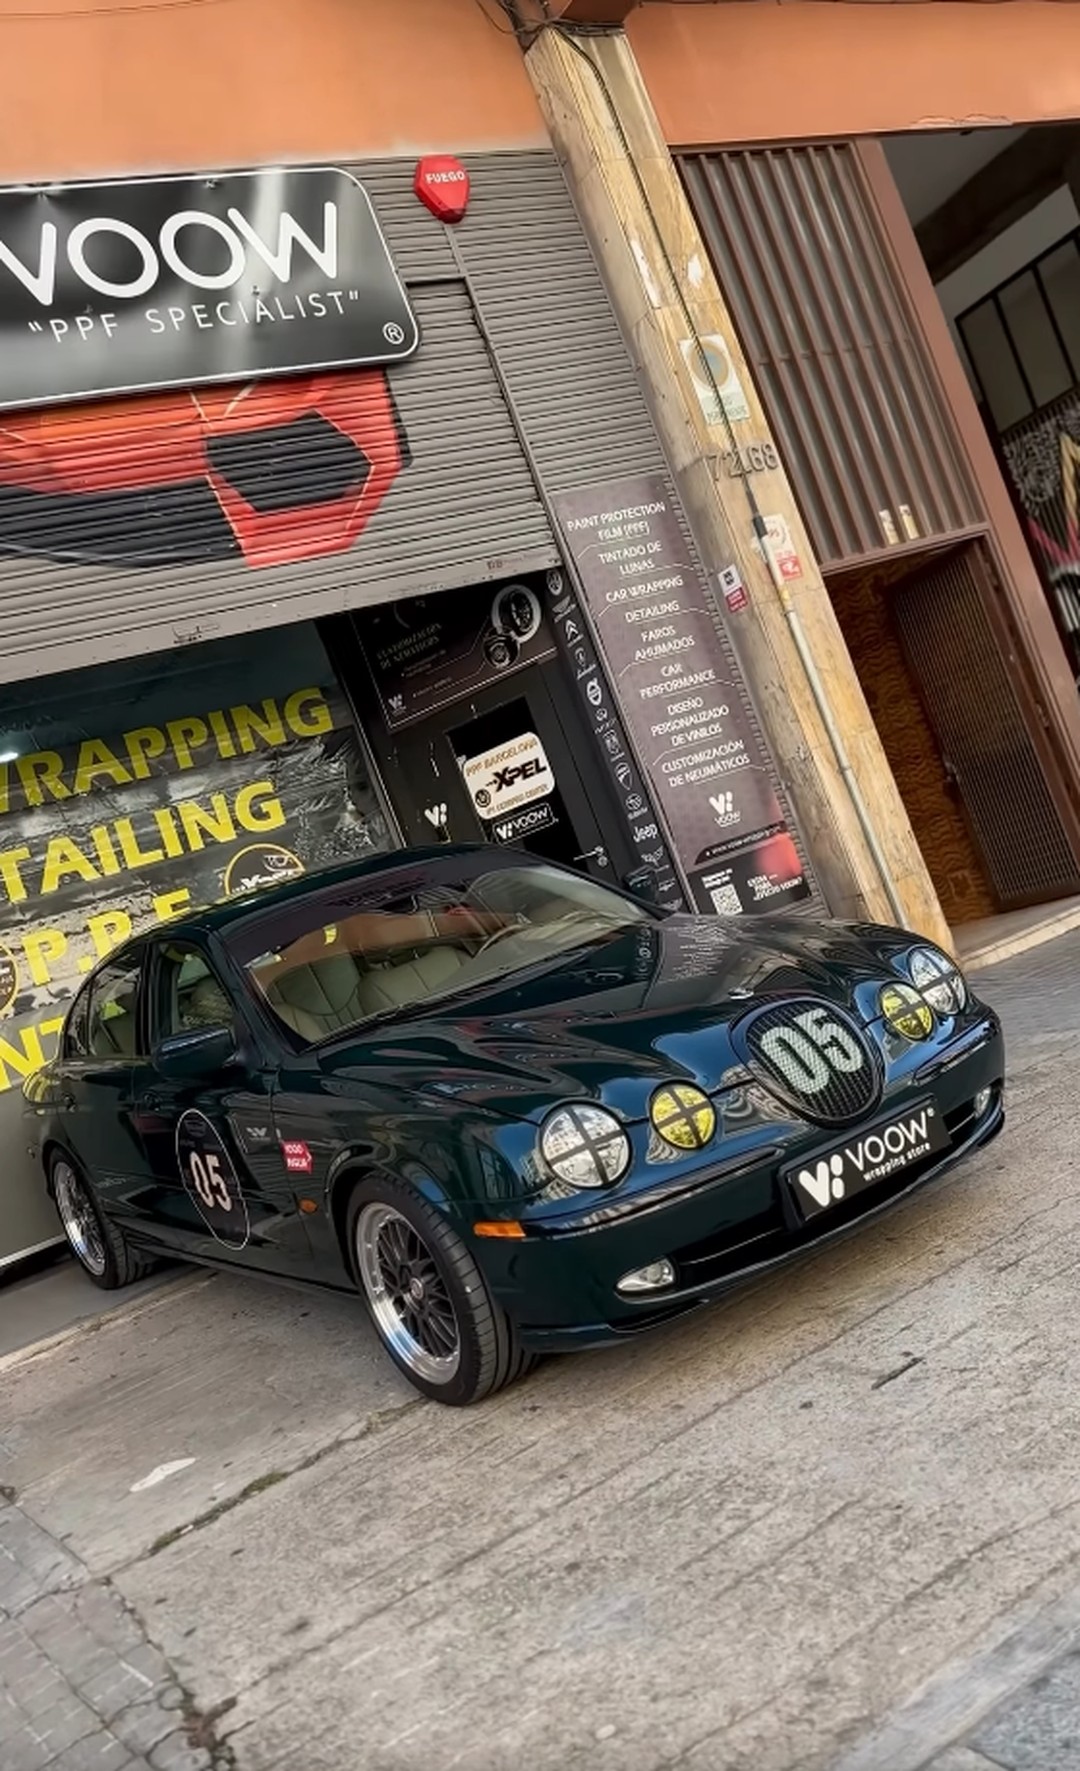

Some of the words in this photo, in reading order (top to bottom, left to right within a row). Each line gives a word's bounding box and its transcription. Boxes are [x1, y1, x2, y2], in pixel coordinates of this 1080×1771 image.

[425, 169, 466, 185] FUEGO
[0, 201, 337, 306] VOOW
[567, 512, 600, 532] PAINT
[600, 501, 666, 526] PROTECTION
[598, 525, 624, 541] FILM
[598, 544, 645, 566] TINTADO
[645, 540, 663, 554] DE
[618, 558, 656, 576] LUNAS
[605, 586, 629, 603] CAR
[629, 574, 684, 600] WRAPPING
[625, 600, 680, 623] DETAILING
[634, 634, 696, 661] AHUMADOS
[640, 625, 677, 643] FAROS
[660, 663, 684, 677] CAR
[638, 668, 717, 700] PERFORMANCE
[650, 703, 731, 737] PERSONALIZADO
[671, 731, 686, 748] DE
[685, 721, 724, 744] VINILOS
[493, 757, 548, 793] XPEL
[668, 772, 685, 788] DE
[633, 823, 658, 842] Jeep
[760, 1007, 864, 1095] 05
[862, 1153, 907, 1183] wrapping
[906, 1141, 932, 1161] store
[189, 1151, 232, 1212] 05
